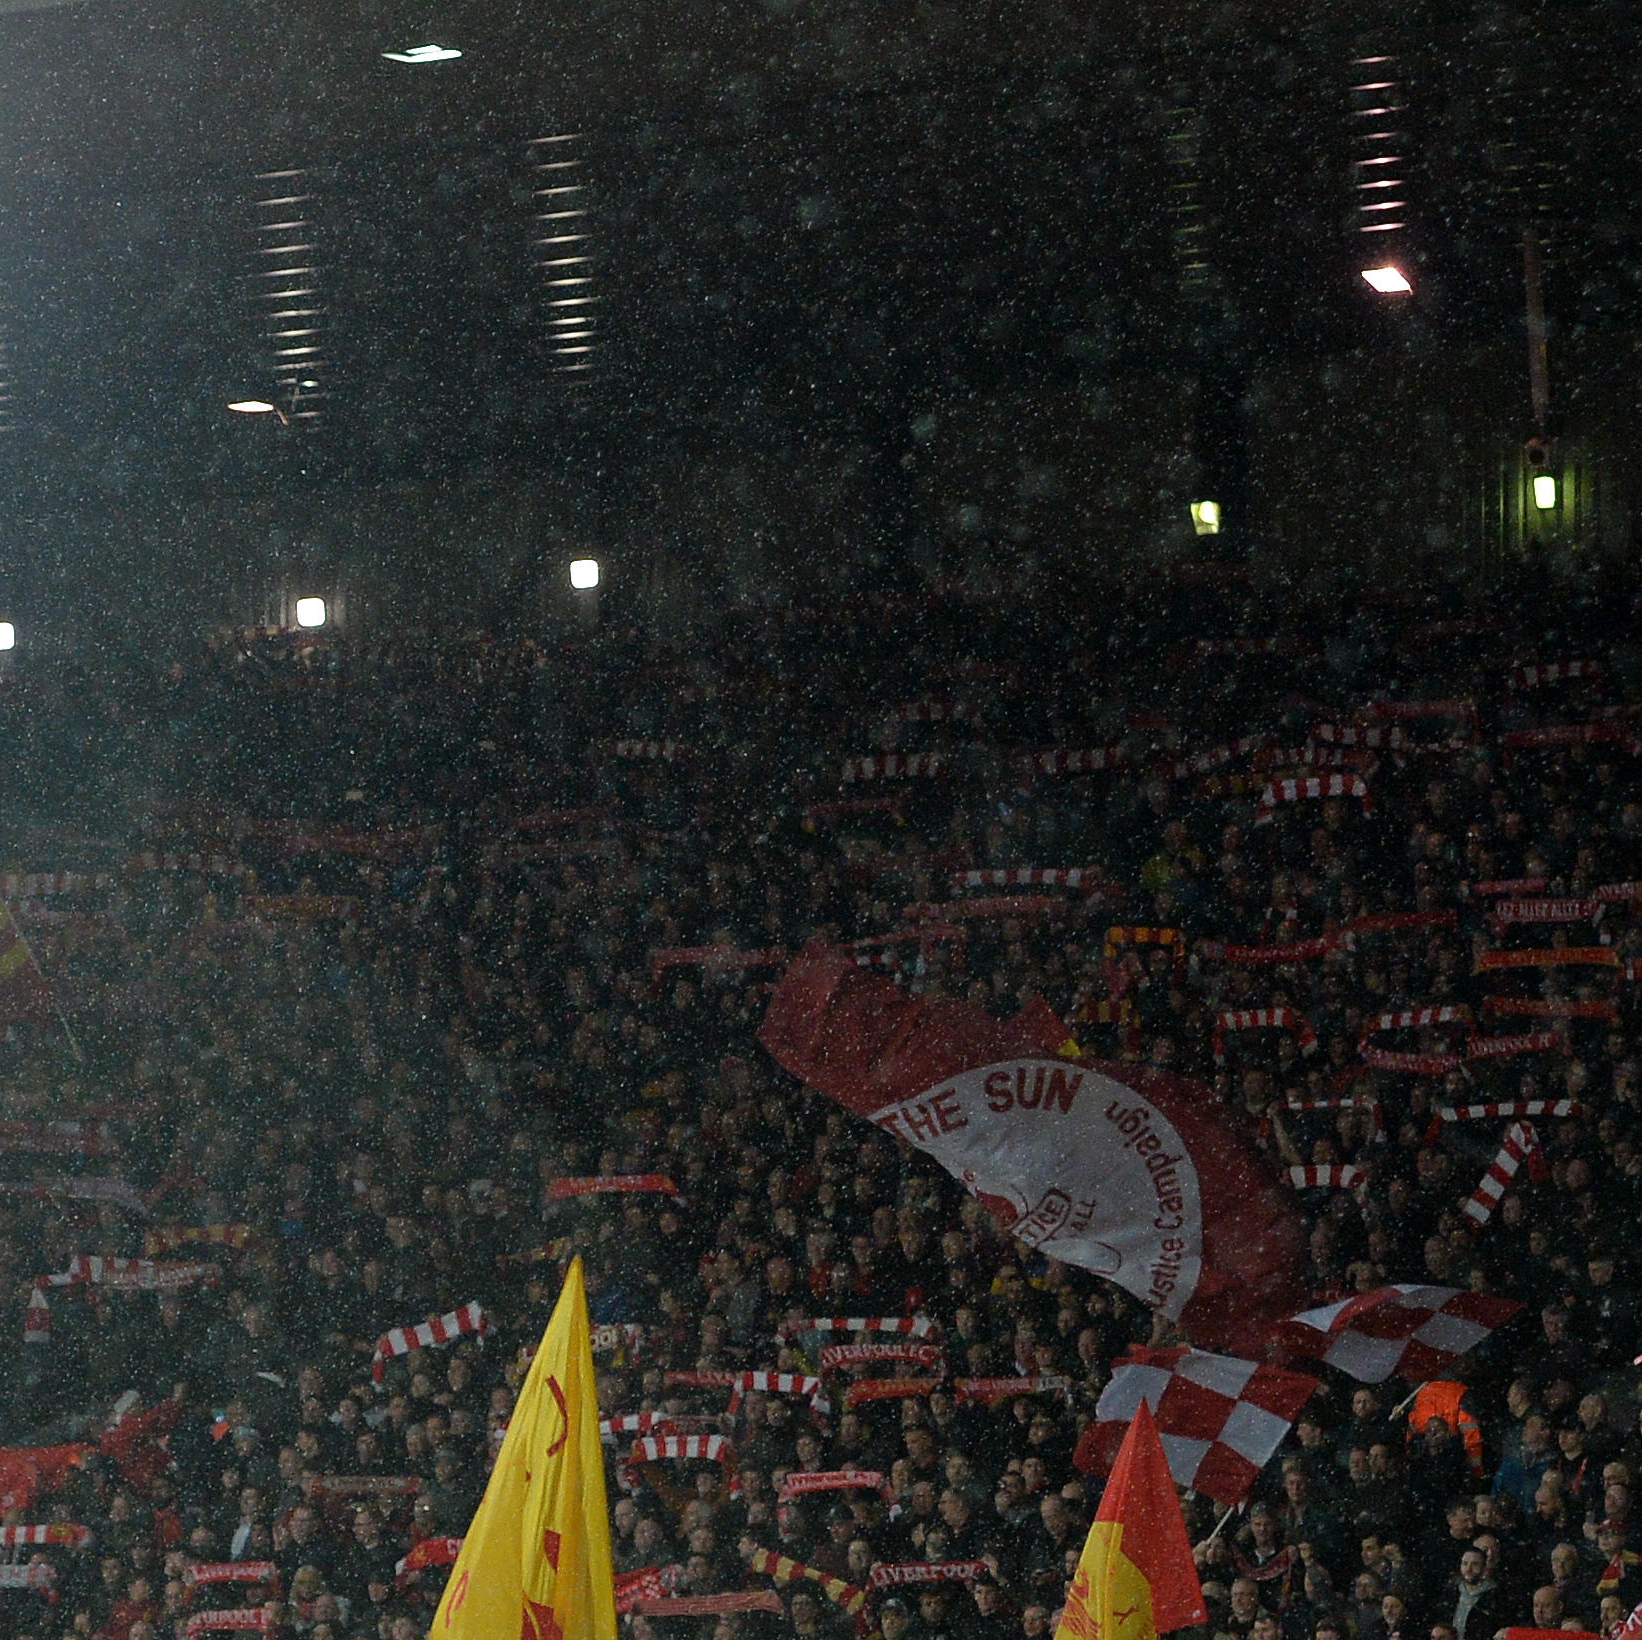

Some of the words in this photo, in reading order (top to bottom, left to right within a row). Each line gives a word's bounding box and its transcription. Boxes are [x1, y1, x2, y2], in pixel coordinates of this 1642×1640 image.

[876, 1089, 969, 1144] THE
[983, 1067, 1084, 1116] SUN
[1149, 1232, 1185, 1308] ustice
